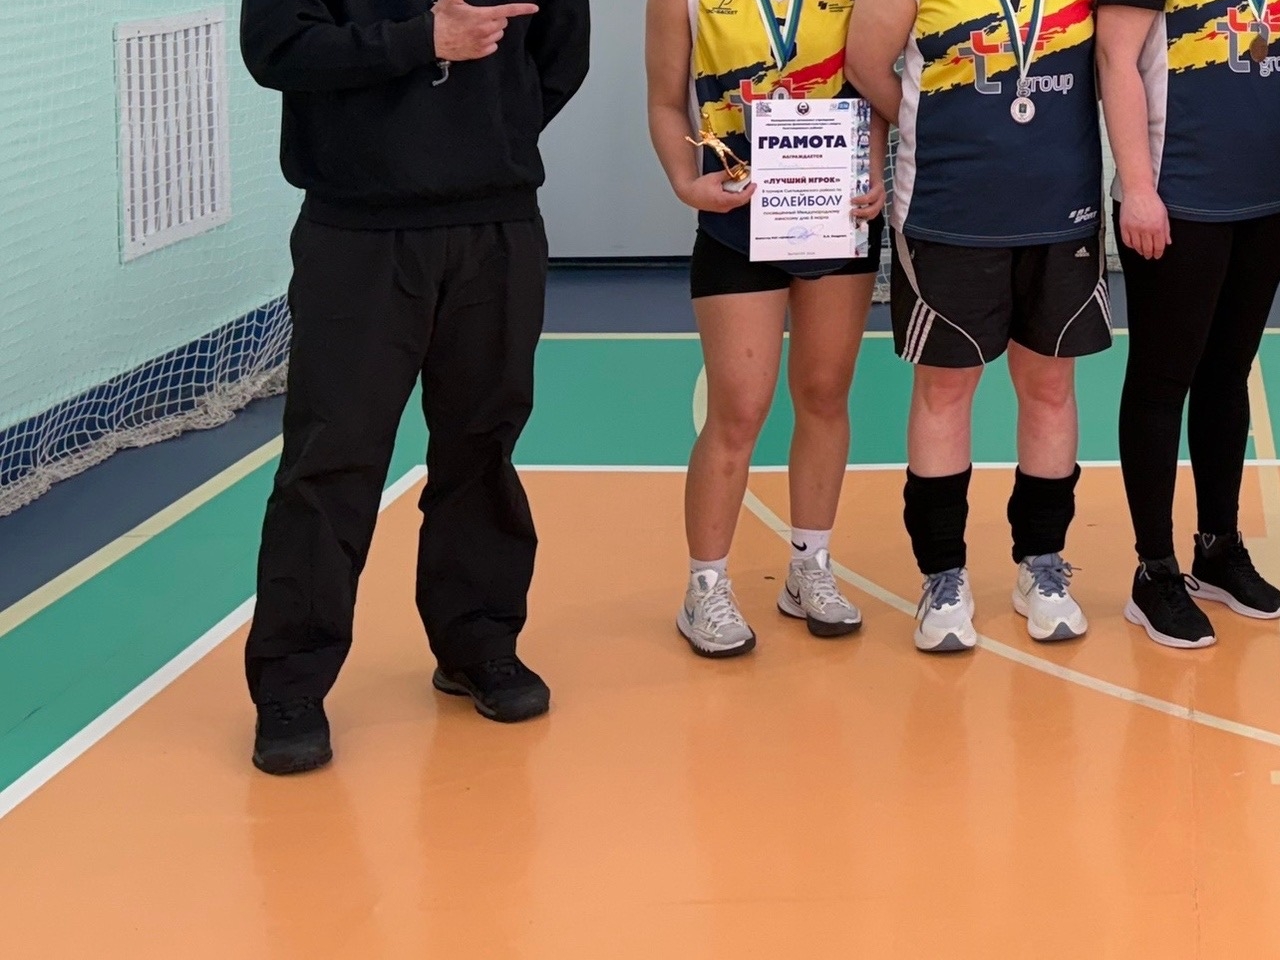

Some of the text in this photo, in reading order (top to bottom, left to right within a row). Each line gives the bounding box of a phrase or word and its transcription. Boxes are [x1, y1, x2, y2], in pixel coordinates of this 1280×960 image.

[1017, 73, 1074, 98] group
[758, 135, 847, 150] ГРАМОТА
[763, 176, 841, 184] «ЛУЧШИЙ ИГРОК»
[761, 193, 843, 208] ВОЛЕЙБОЛУ
